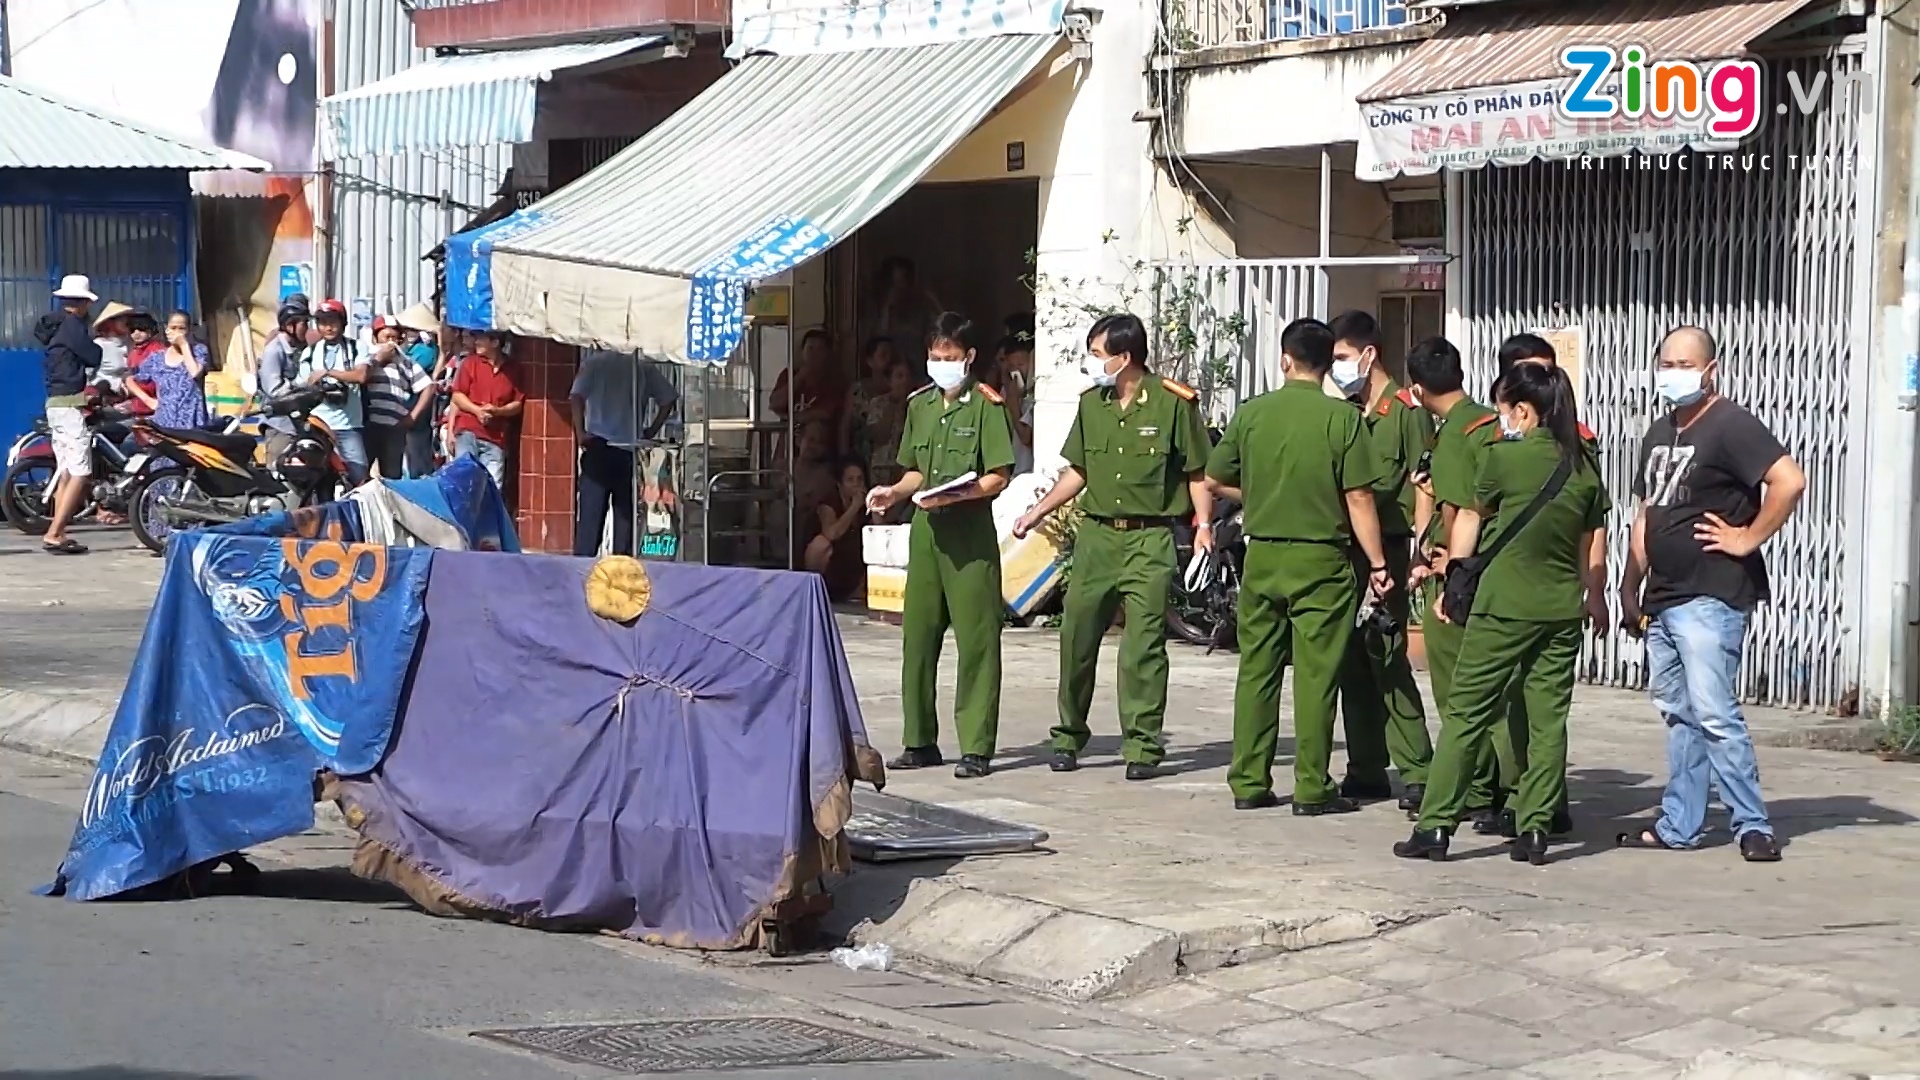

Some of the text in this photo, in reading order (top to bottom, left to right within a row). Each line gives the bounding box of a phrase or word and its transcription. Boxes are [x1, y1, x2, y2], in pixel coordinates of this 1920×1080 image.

[1370, 109, 1413, 128] CÔNG
[1419, 105, 1438, 120] TY
[1411, 121, 1484, 153] MAI
[1497, 112, 1555, 146] AN
[152, 703, 284, 788] Acclaimed
